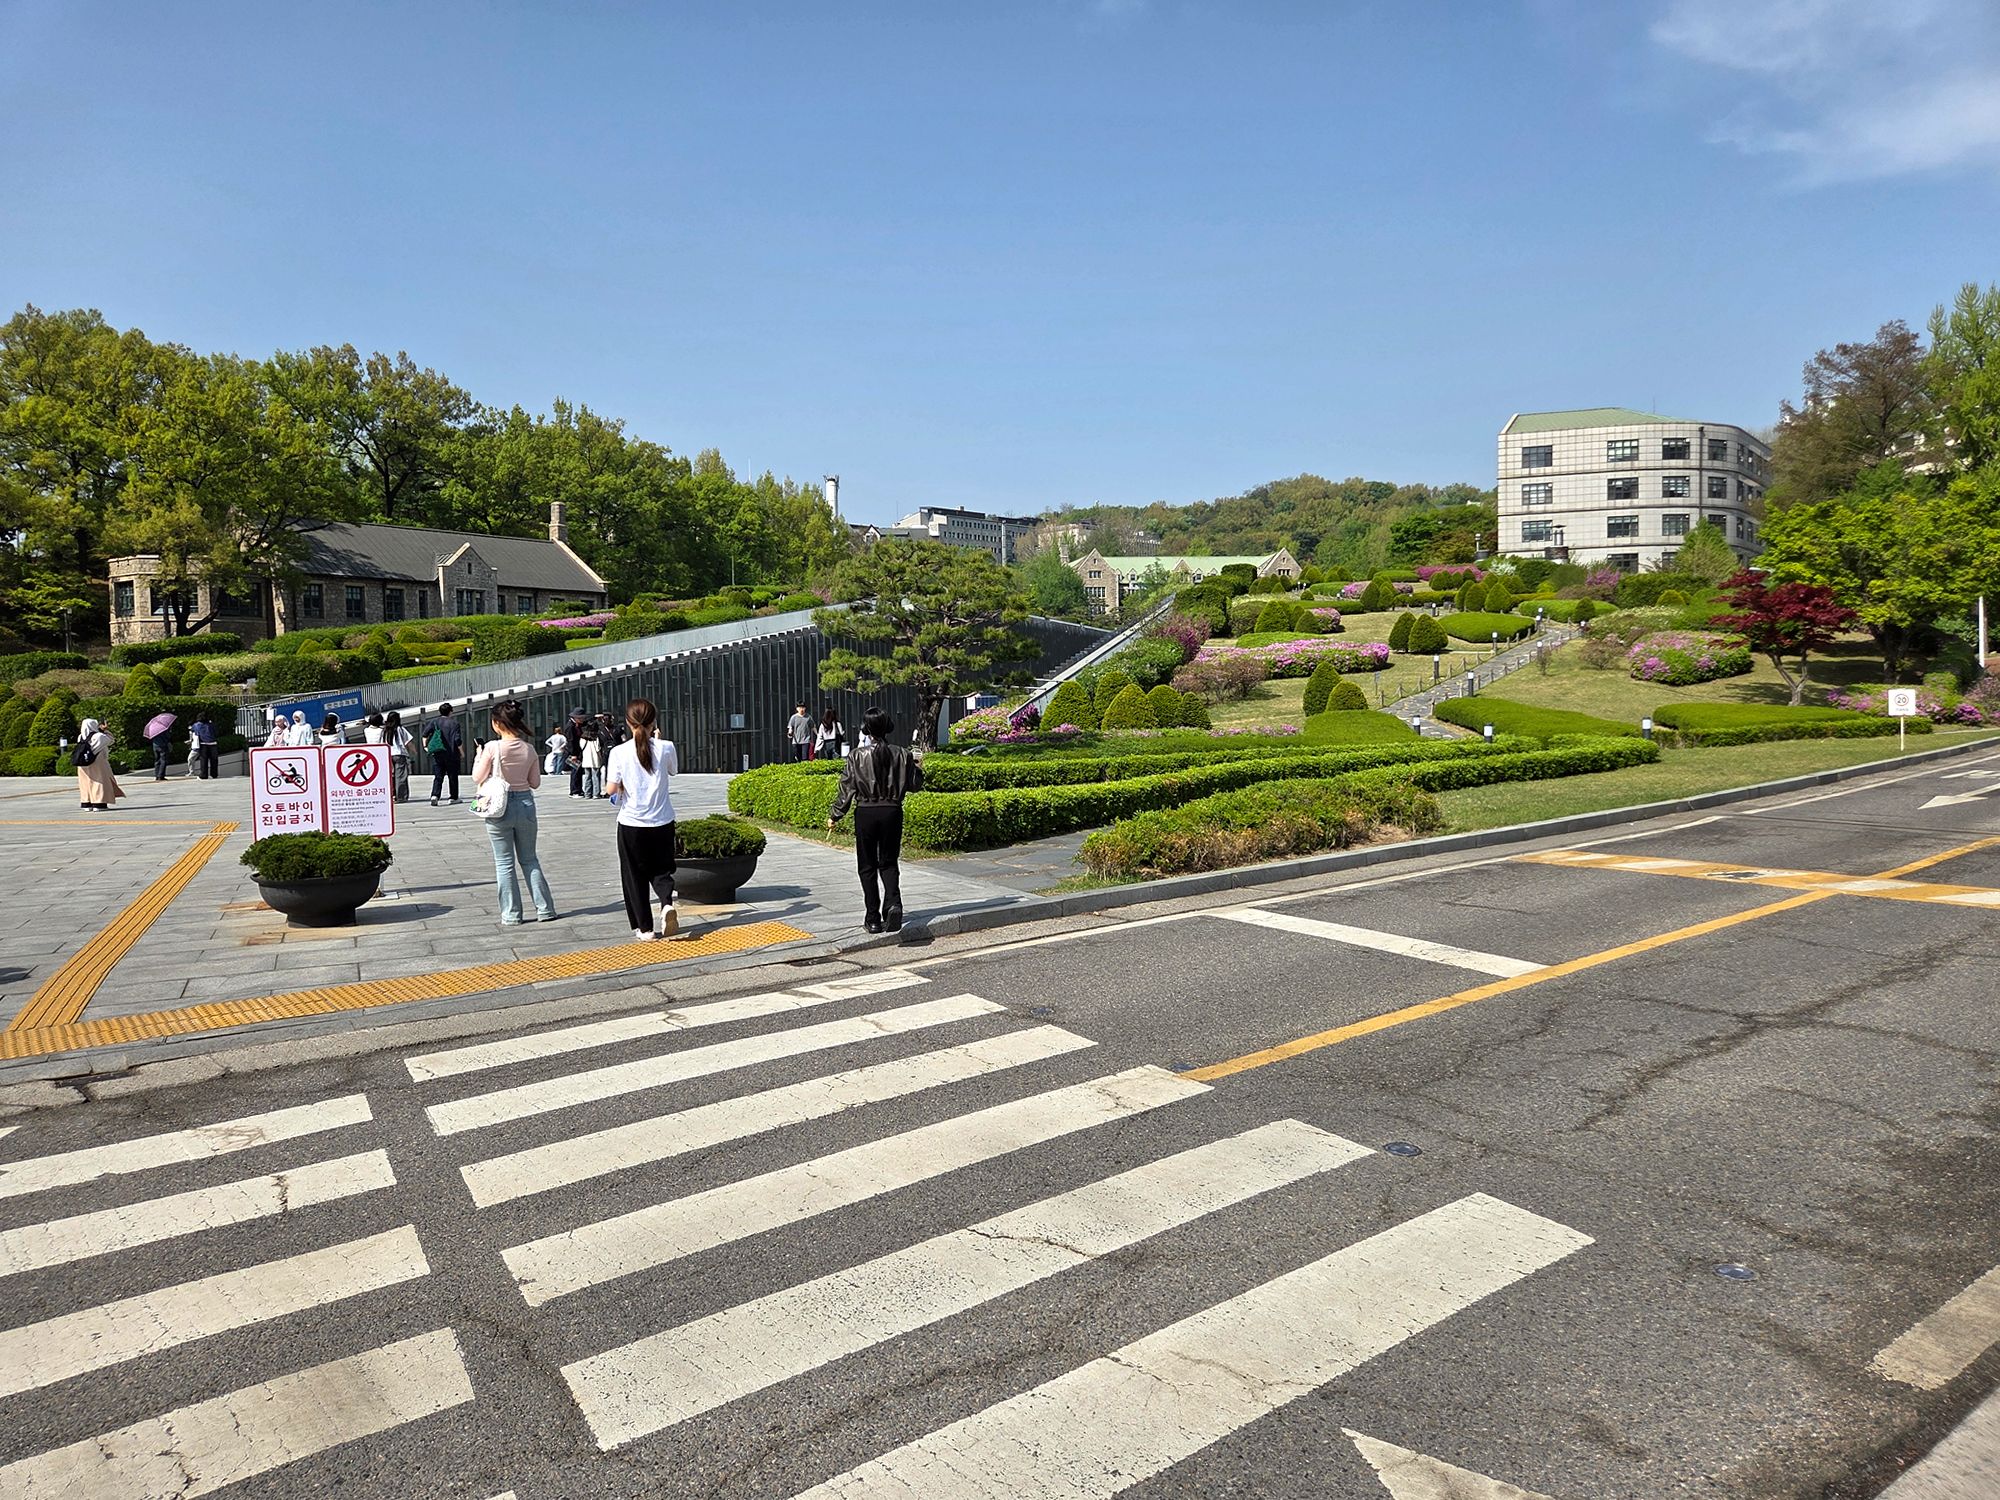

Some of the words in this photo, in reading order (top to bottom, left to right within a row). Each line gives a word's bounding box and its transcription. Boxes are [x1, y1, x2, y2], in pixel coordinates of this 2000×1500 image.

[1897, 696, 1907, 704] 20
[331, 789, 353, 798] 외부인
[356, 788, 386, 797] 출입금지
[261, 801, 313, 813] 오토바이
[262, 813, 314, 826] 진입금지
